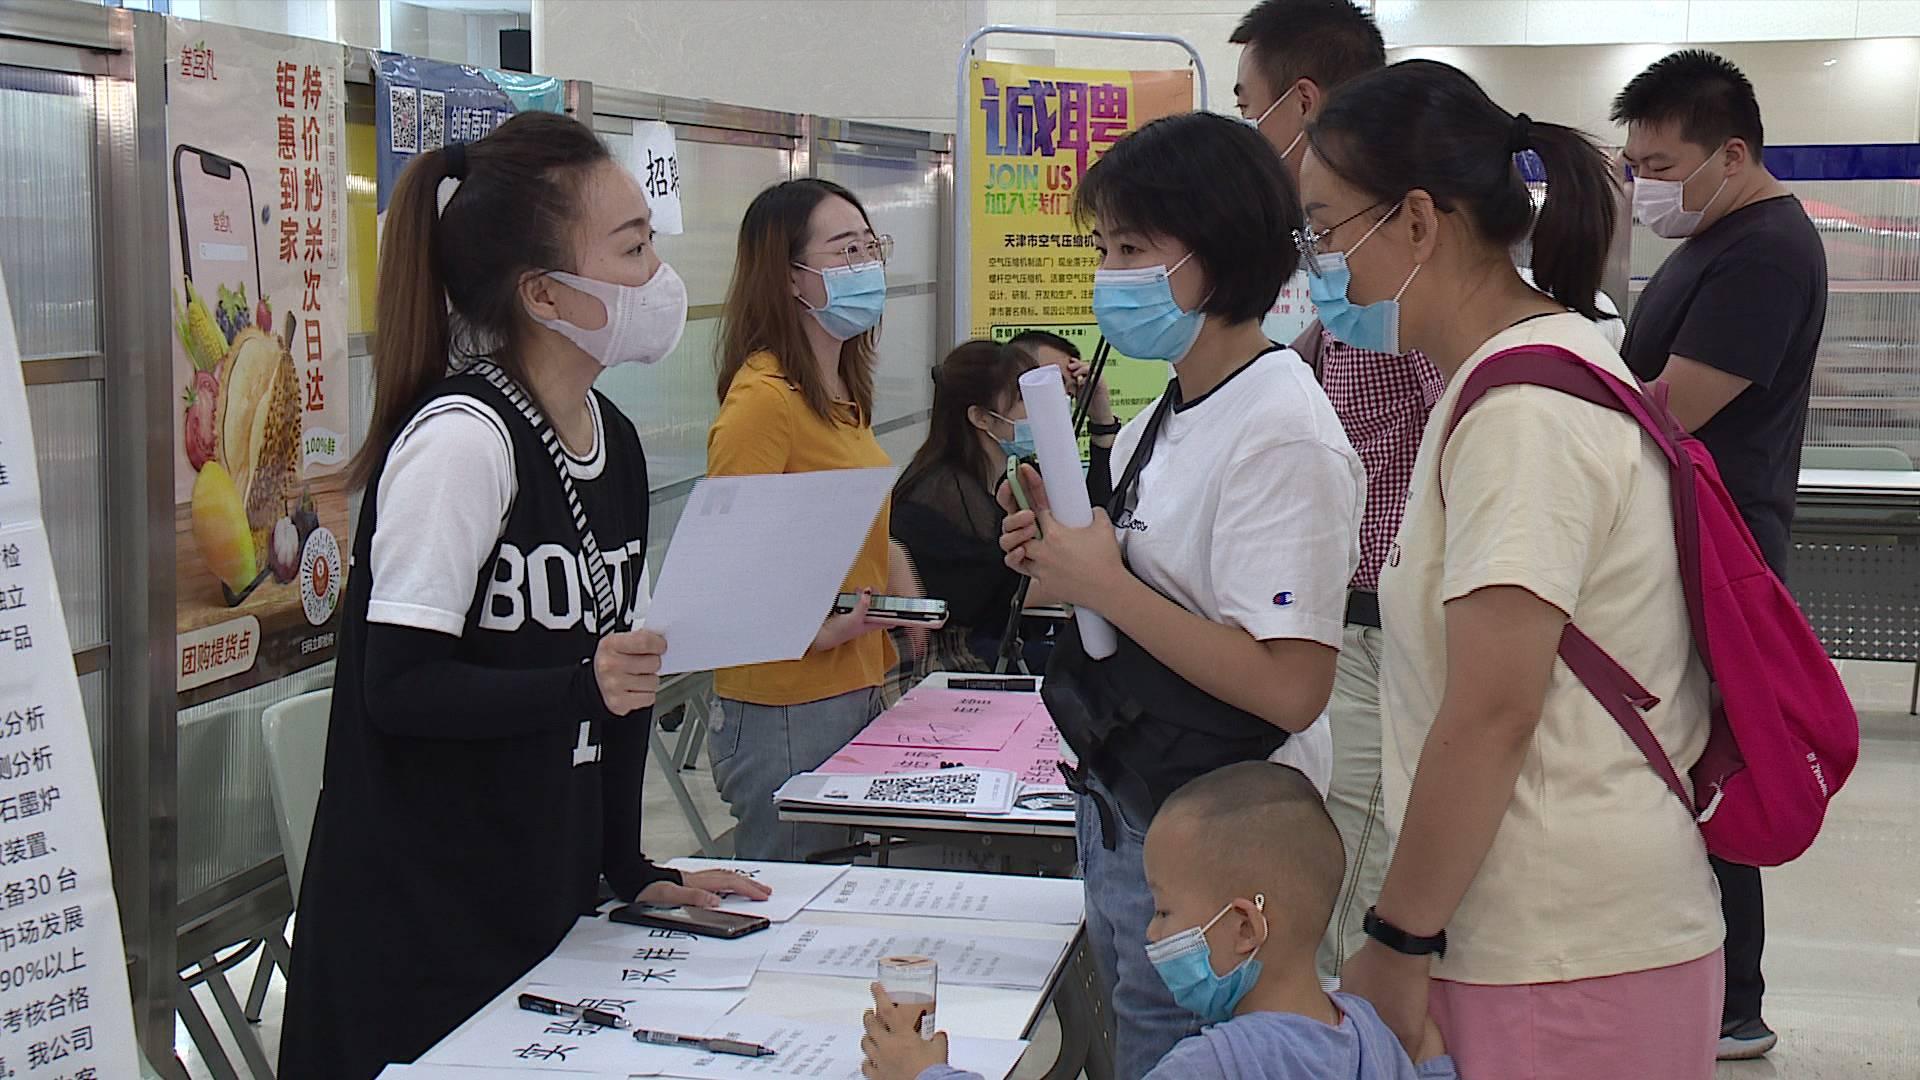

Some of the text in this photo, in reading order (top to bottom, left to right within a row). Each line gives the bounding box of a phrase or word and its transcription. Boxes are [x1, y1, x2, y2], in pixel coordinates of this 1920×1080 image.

[276, 61, 298, 263] 钜惠到家
[984, 164, 1072, 190] JOIN US
[984, 192, 1072, 215] 加入我们
[302, 64, 324, 413] 特价秒杀次日达
[181, 631, 251, 677] 团购提货点
[0, 705, 45, 738] 分析
[0, 785, 60, 823] 石墨炉
[0, 831, 57, 866] 装置、
[0, 874, 51, 911] 备30
[0, 905, 84, 952] 市场发展
[0, 946, 87, 992] 90%以上
